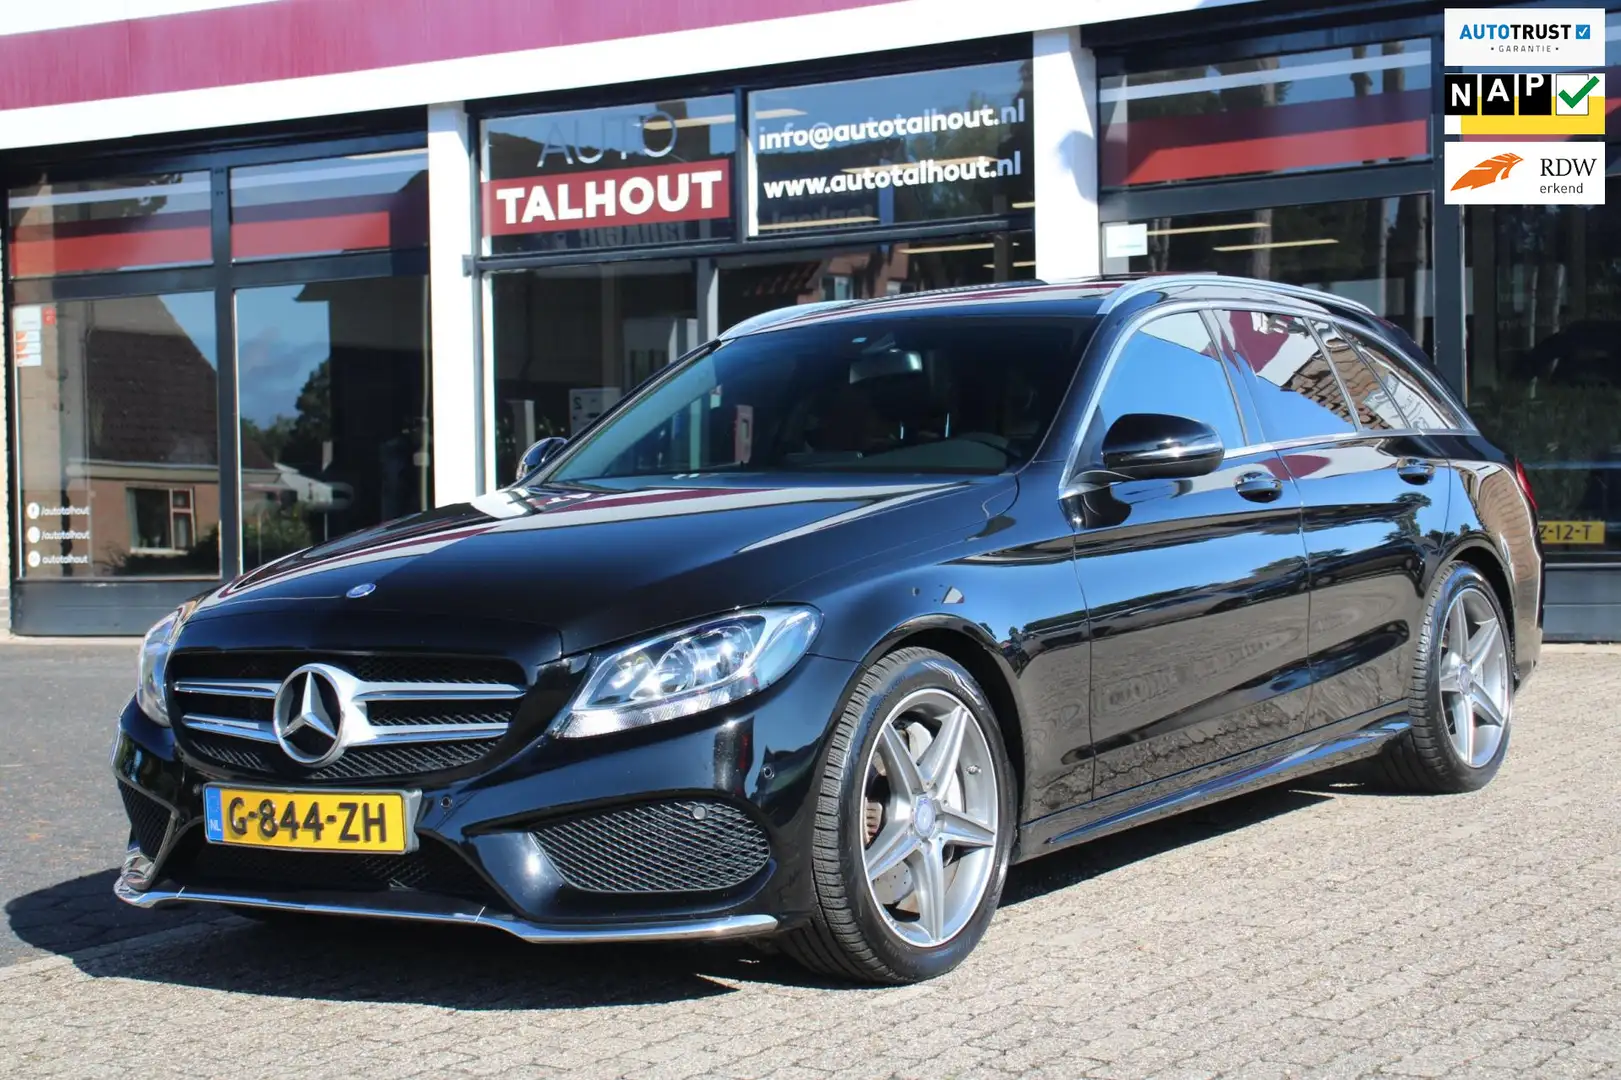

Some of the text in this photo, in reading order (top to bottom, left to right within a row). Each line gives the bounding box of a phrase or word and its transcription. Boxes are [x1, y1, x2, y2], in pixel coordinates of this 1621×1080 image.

[537, 111, 678, 168] AUTO
[759, 98, 1025, 150] info@autotalhout.nl
[496, 170, 722, 225] TALHOUT
[764, 151, 1022, 199] www.autotalhout.nl
[210, 819, 221, 831] NL
[229, 797, 387, 842] G-844-ZH
